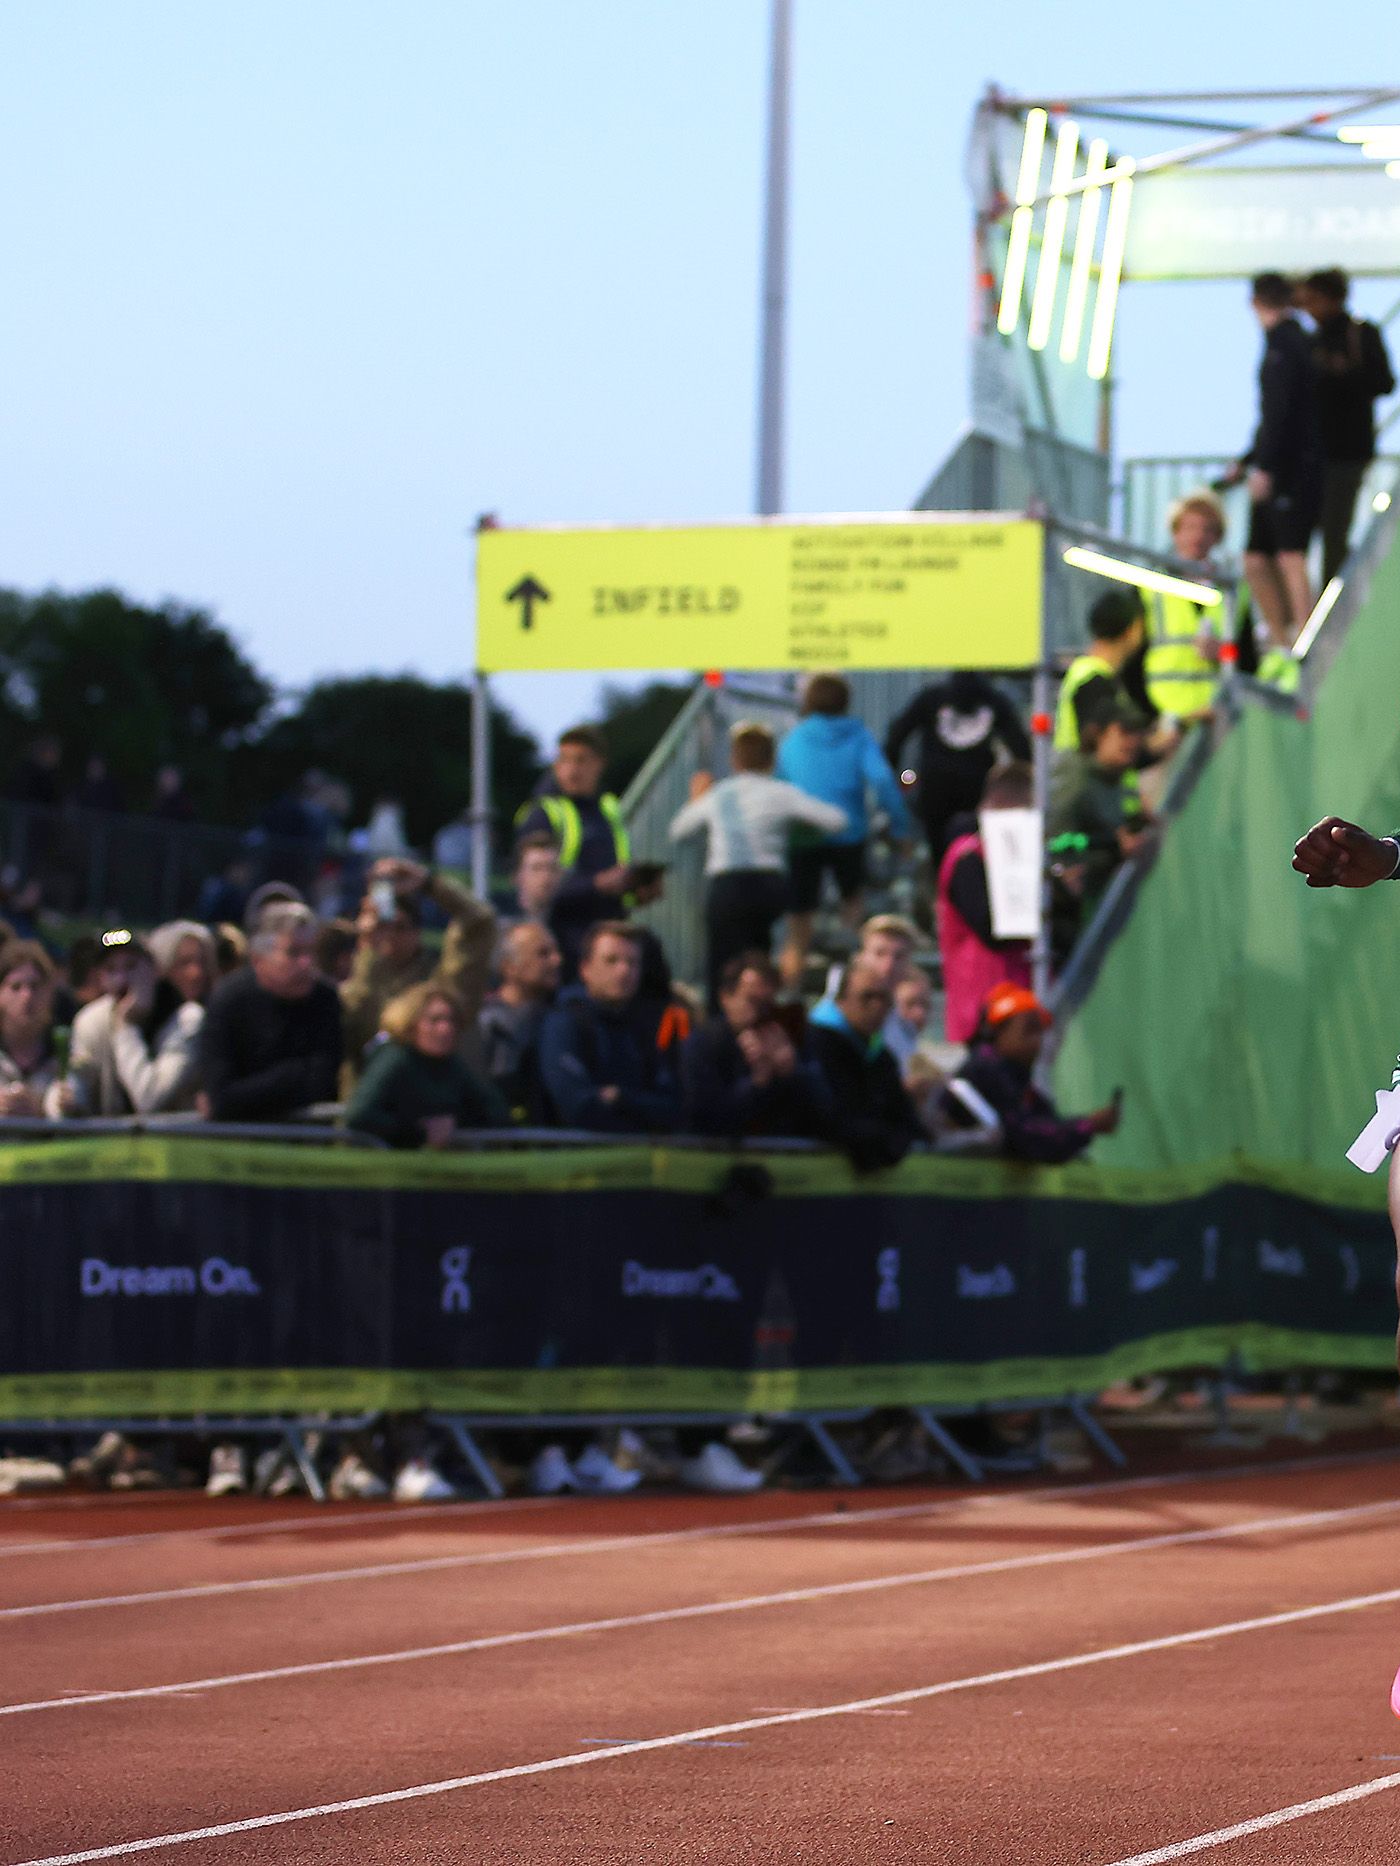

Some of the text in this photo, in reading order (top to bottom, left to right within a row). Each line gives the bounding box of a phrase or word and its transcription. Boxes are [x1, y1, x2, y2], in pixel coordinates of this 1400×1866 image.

[592, 584, 743, 616] INFIELD
[80, 1256, 260, 1296] Dream On.
